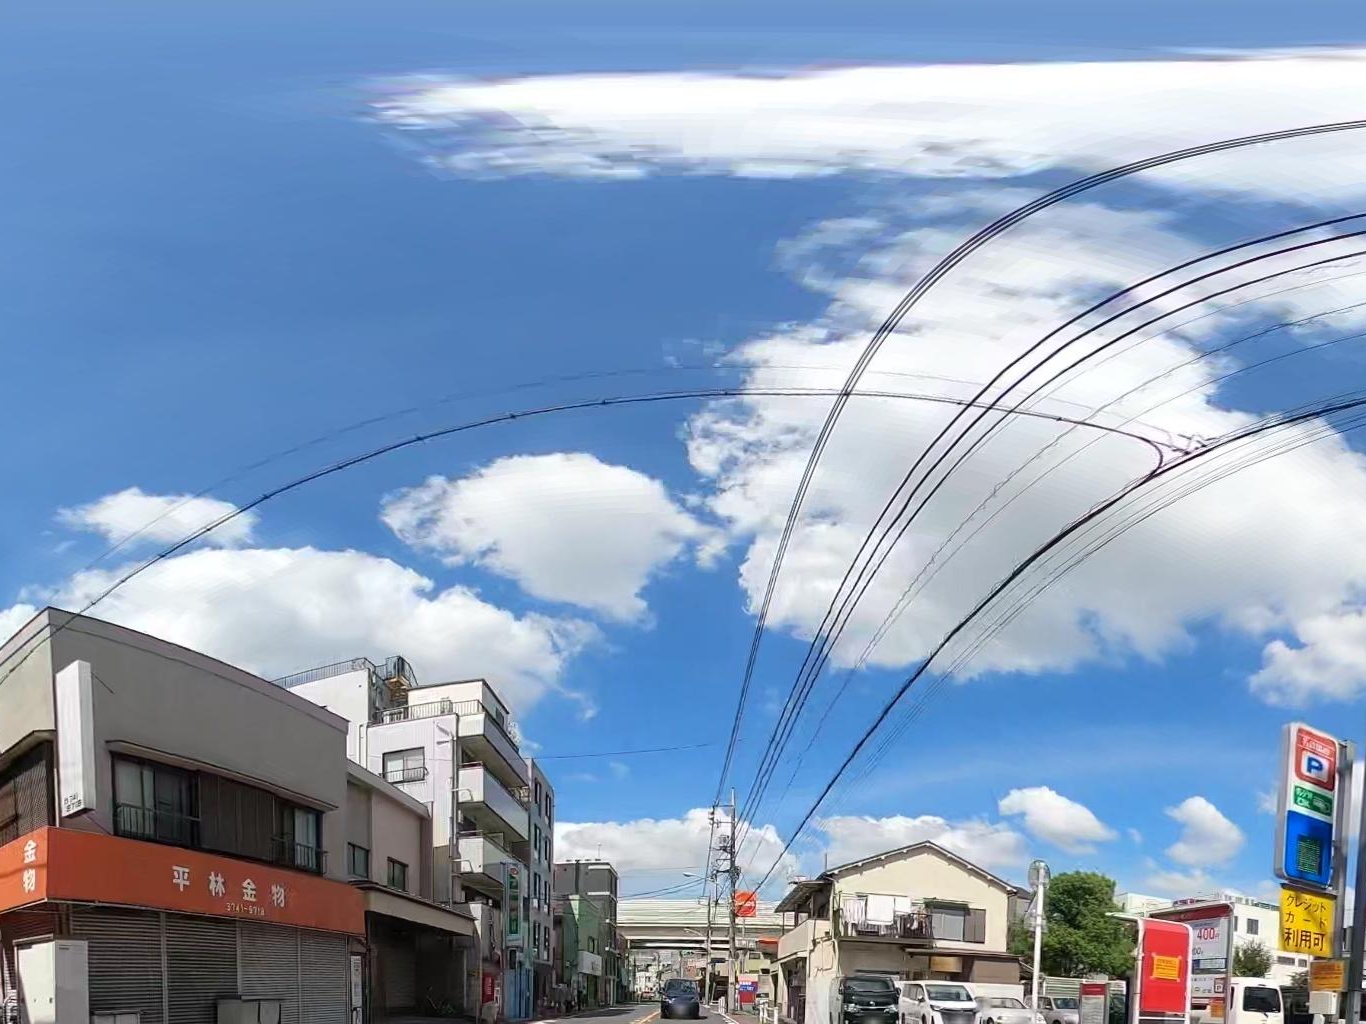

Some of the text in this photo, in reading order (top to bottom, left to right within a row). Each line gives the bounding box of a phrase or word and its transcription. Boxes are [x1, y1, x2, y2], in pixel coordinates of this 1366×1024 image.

[1306, 755, 1324, 774] P
[22, 839, 37, 894] 金物
[172, 865, 286, 908] 平林金物
[1285, 894, 1327, 913] クレジット
[1285, 911, 1326, 930] カード
[1283, 927, 1327, 952] 利用可
